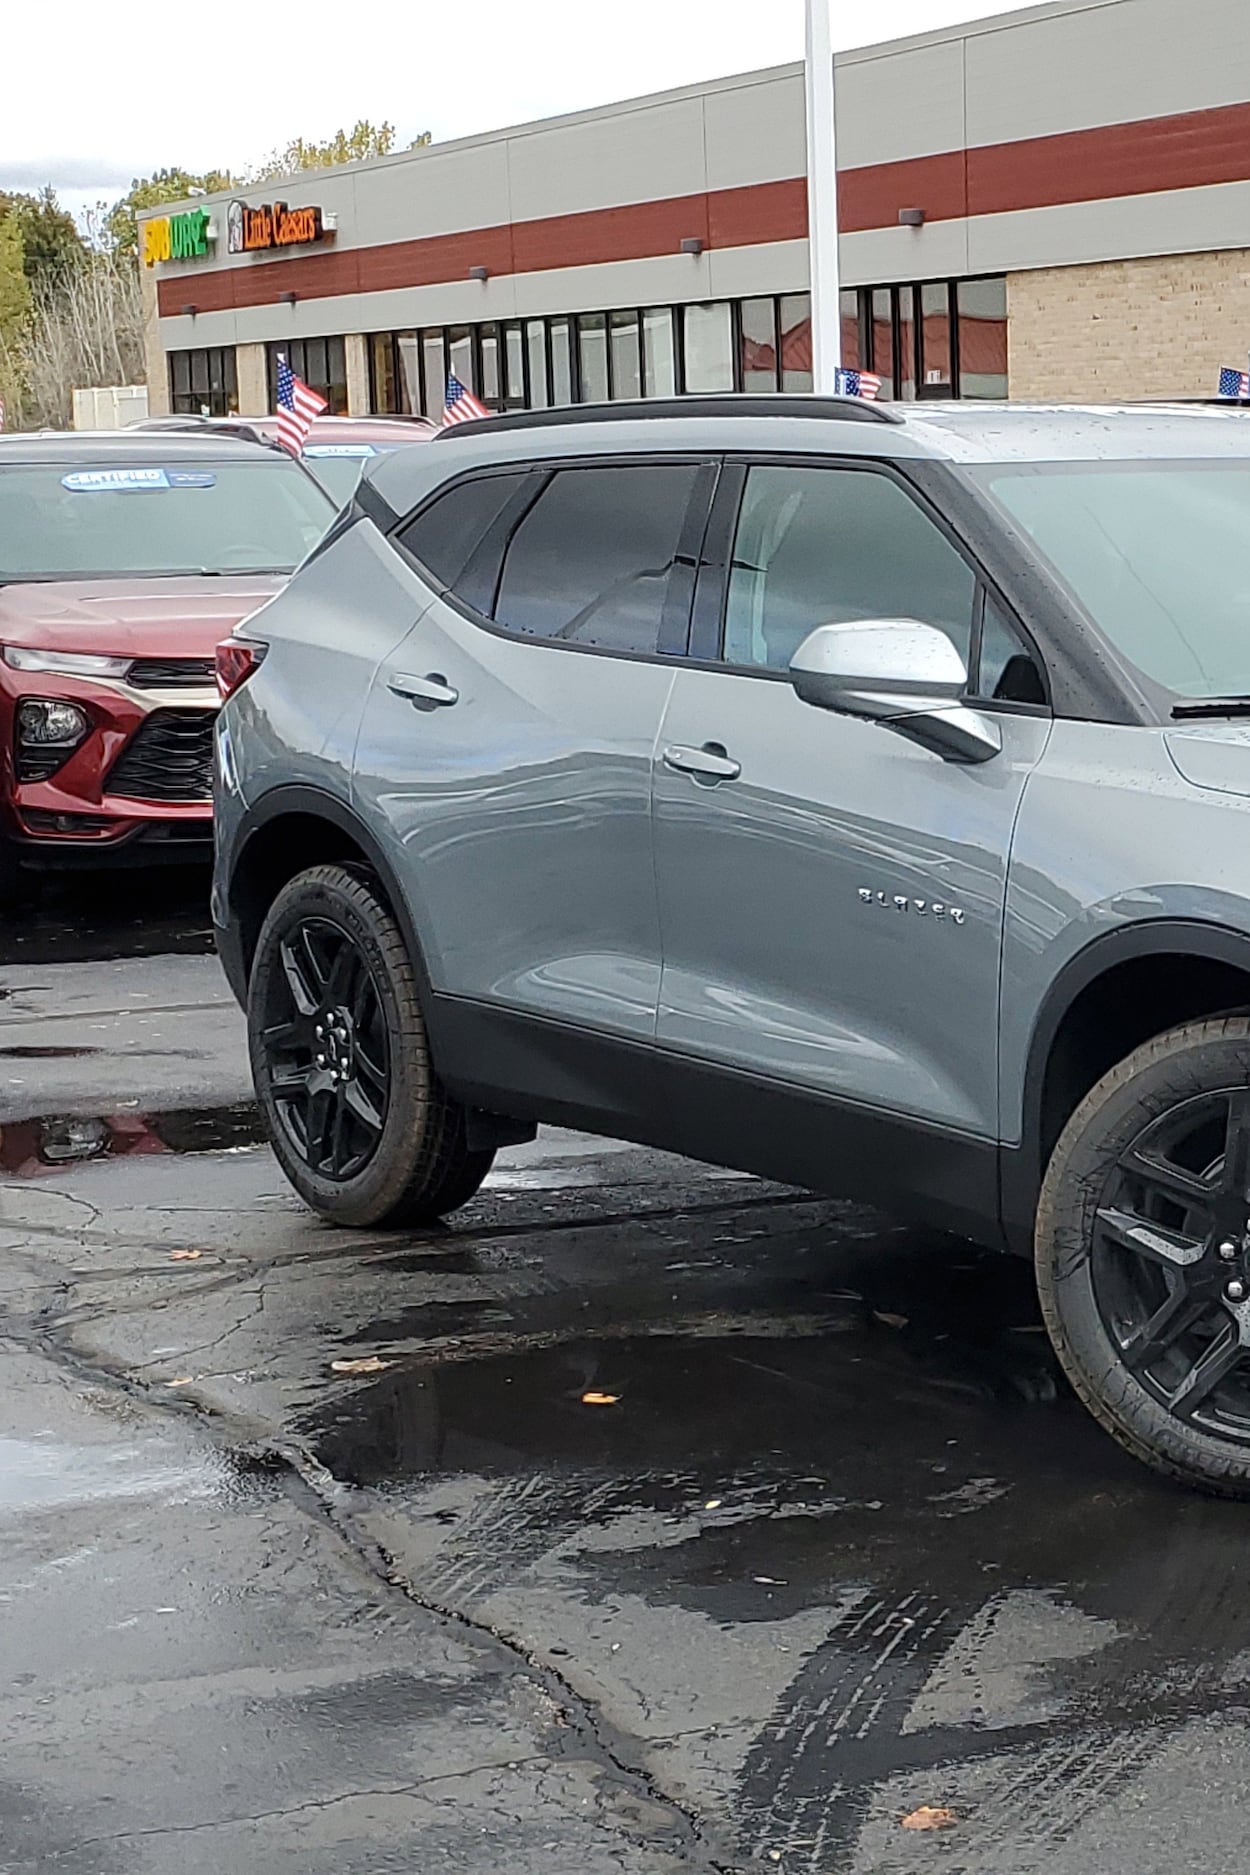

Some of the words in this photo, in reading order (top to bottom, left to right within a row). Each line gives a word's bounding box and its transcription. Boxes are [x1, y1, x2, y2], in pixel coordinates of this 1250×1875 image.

[144, 205, 211, 263] SUBWAY
[244, 206, 272, 248] Little
[273, 203, 316, 245] Caesars
[66, 470, 161, 485] CERTIFIED
[858, 888, 965, 924] BLAZER
